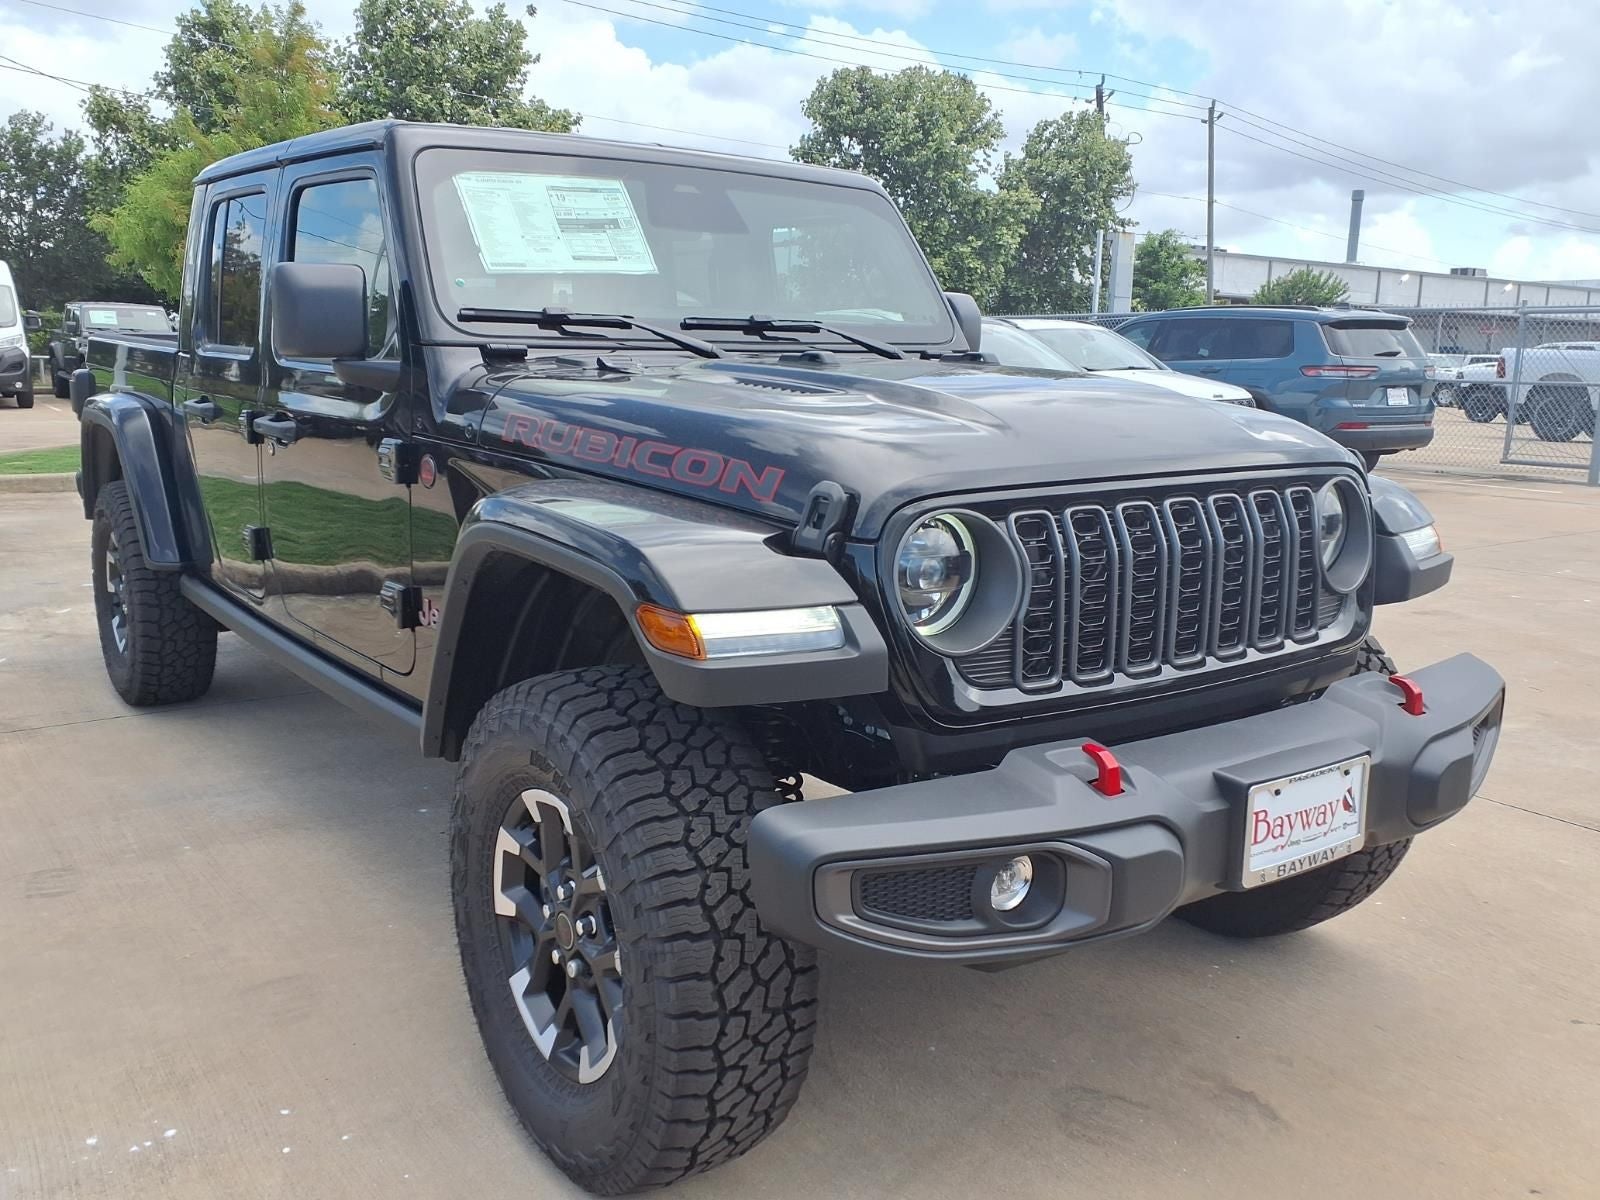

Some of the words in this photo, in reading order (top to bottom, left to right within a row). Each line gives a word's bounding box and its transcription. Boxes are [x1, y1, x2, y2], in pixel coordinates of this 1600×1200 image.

[502, 412, 785, 502] RUBICON
[1251, 799, 1341, 848] Bayway
[1276, 847, 1338, 877] BAYWAY
